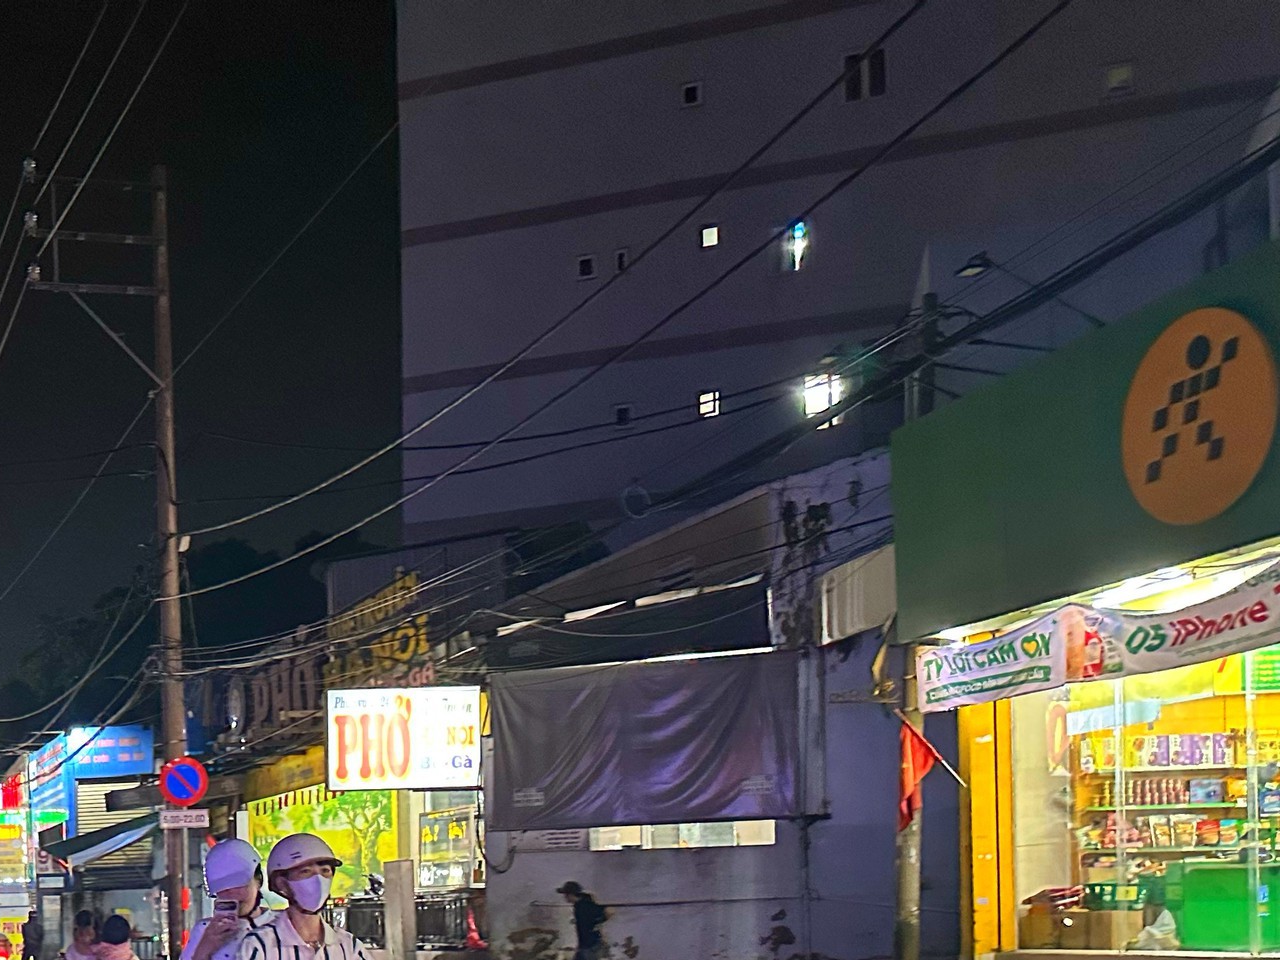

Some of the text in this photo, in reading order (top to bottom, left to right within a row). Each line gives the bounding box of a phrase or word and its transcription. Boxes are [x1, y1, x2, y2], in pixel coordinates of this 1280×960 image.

[1125, 624, 1167, 654] 05
[1169, 600, 1269, 647] iPhone
[333, 694, 412, 781] PHỞ
[451, 755, 473, 769] Gà
